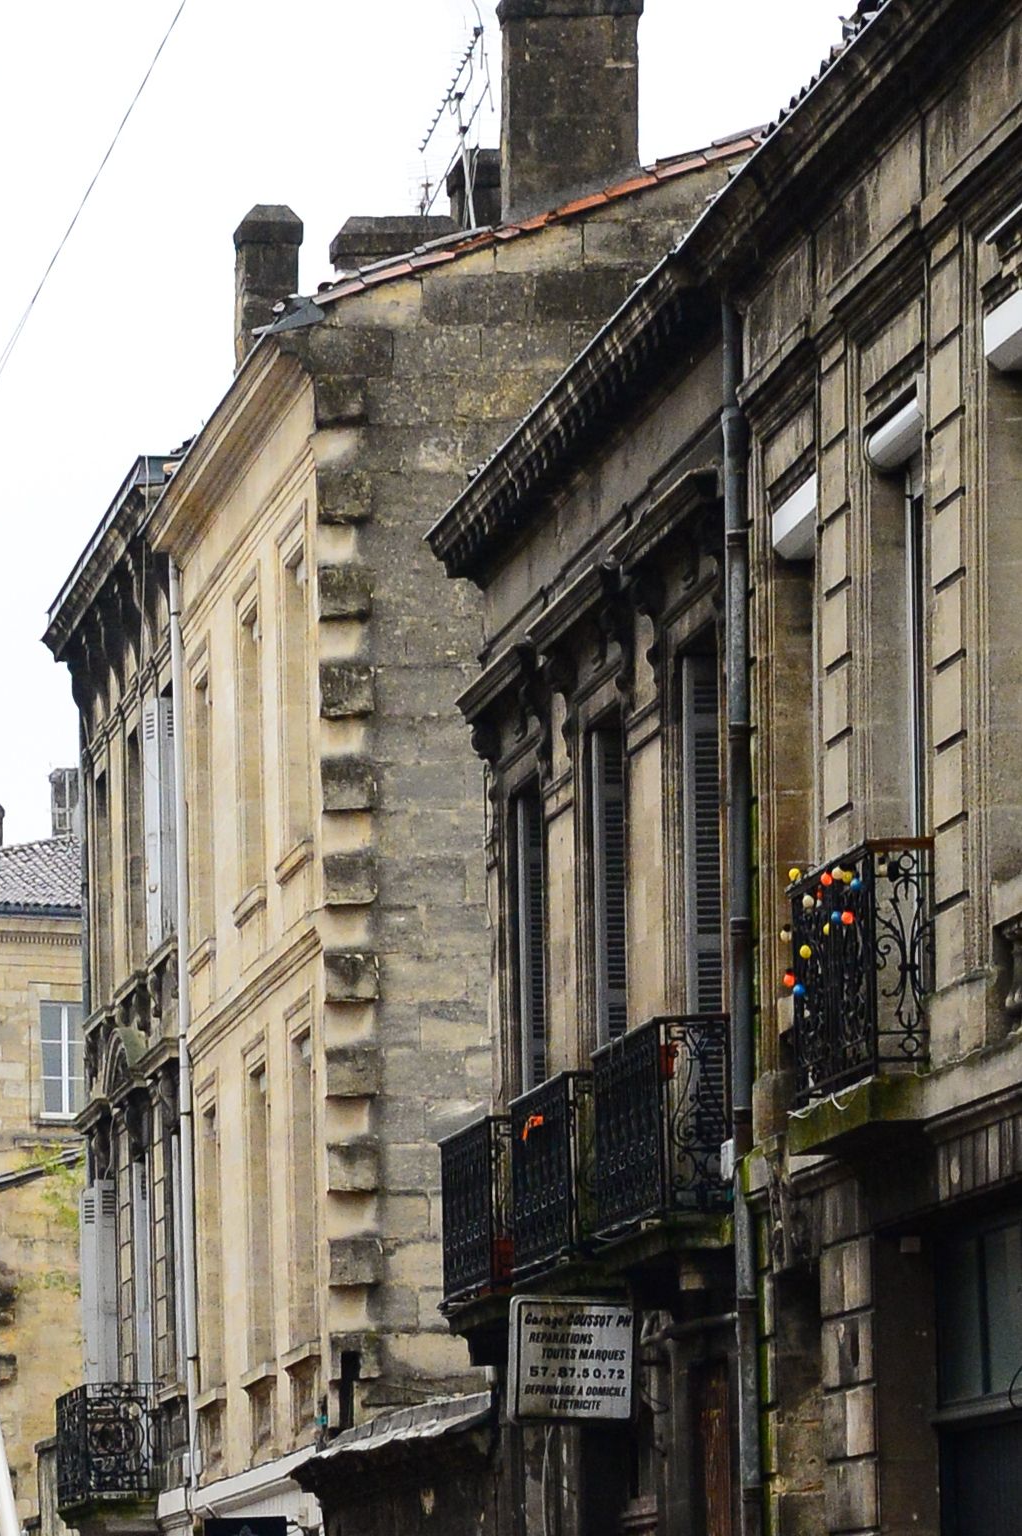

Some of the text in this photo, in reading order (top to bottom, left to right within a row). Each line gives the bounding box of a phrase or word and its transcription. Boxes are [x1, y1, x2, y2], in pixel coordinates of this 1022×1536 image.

[525, 1312, 563, 1329] Garage
[542, 1348, 626, 1362] TOUTES MARQUES
[585, 1386, 627, 1397] DOMICILE
